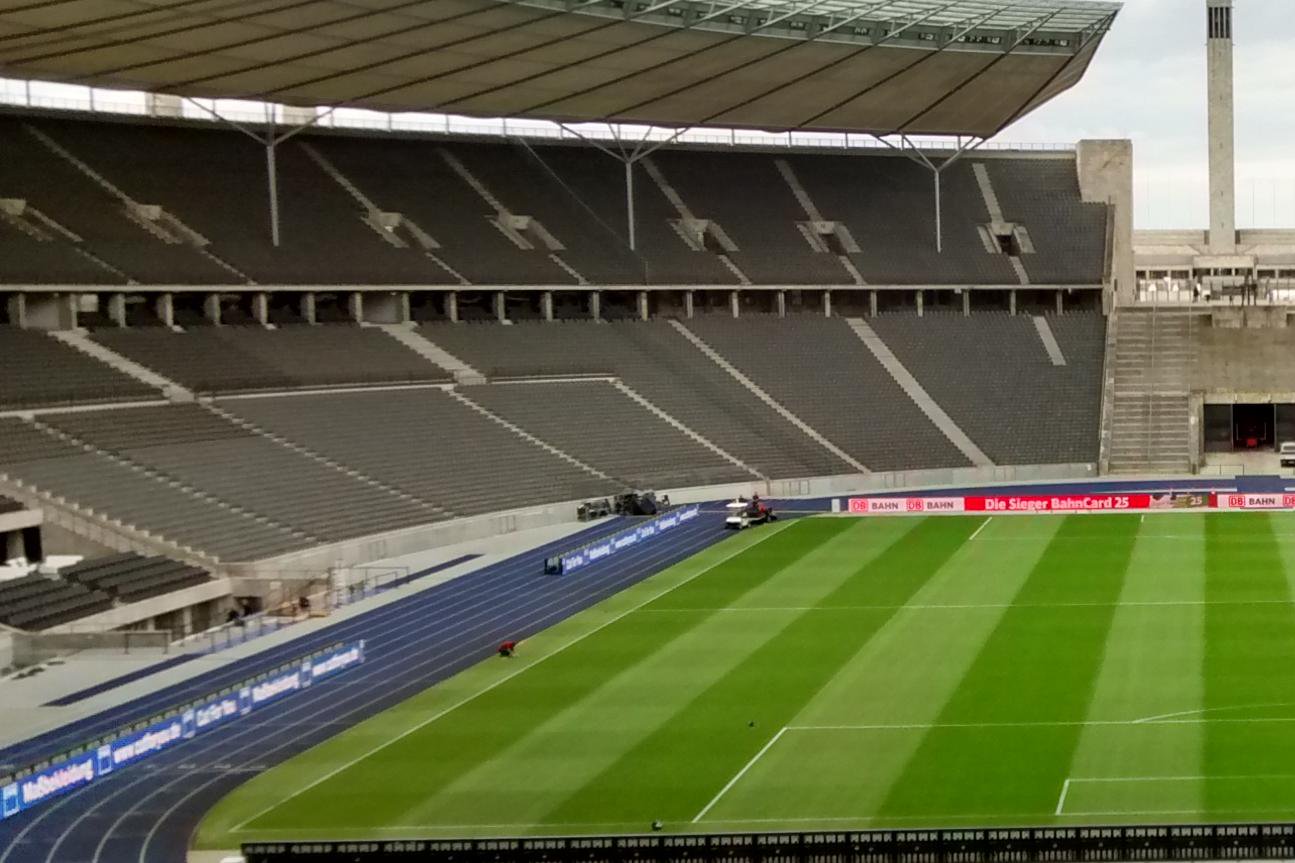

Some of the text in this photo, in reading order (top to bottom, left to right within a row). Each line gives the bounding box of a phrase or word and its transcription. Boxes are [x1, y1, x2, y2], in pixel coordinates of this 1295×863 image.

[871, 501, 899, 510] BAHN
[907, 500, 954, 511] DB BAHN
[985, 496, 1130, 511] Die Sieger BahnCard 25
[1230, 495, 1276, 507] DB BAHN
